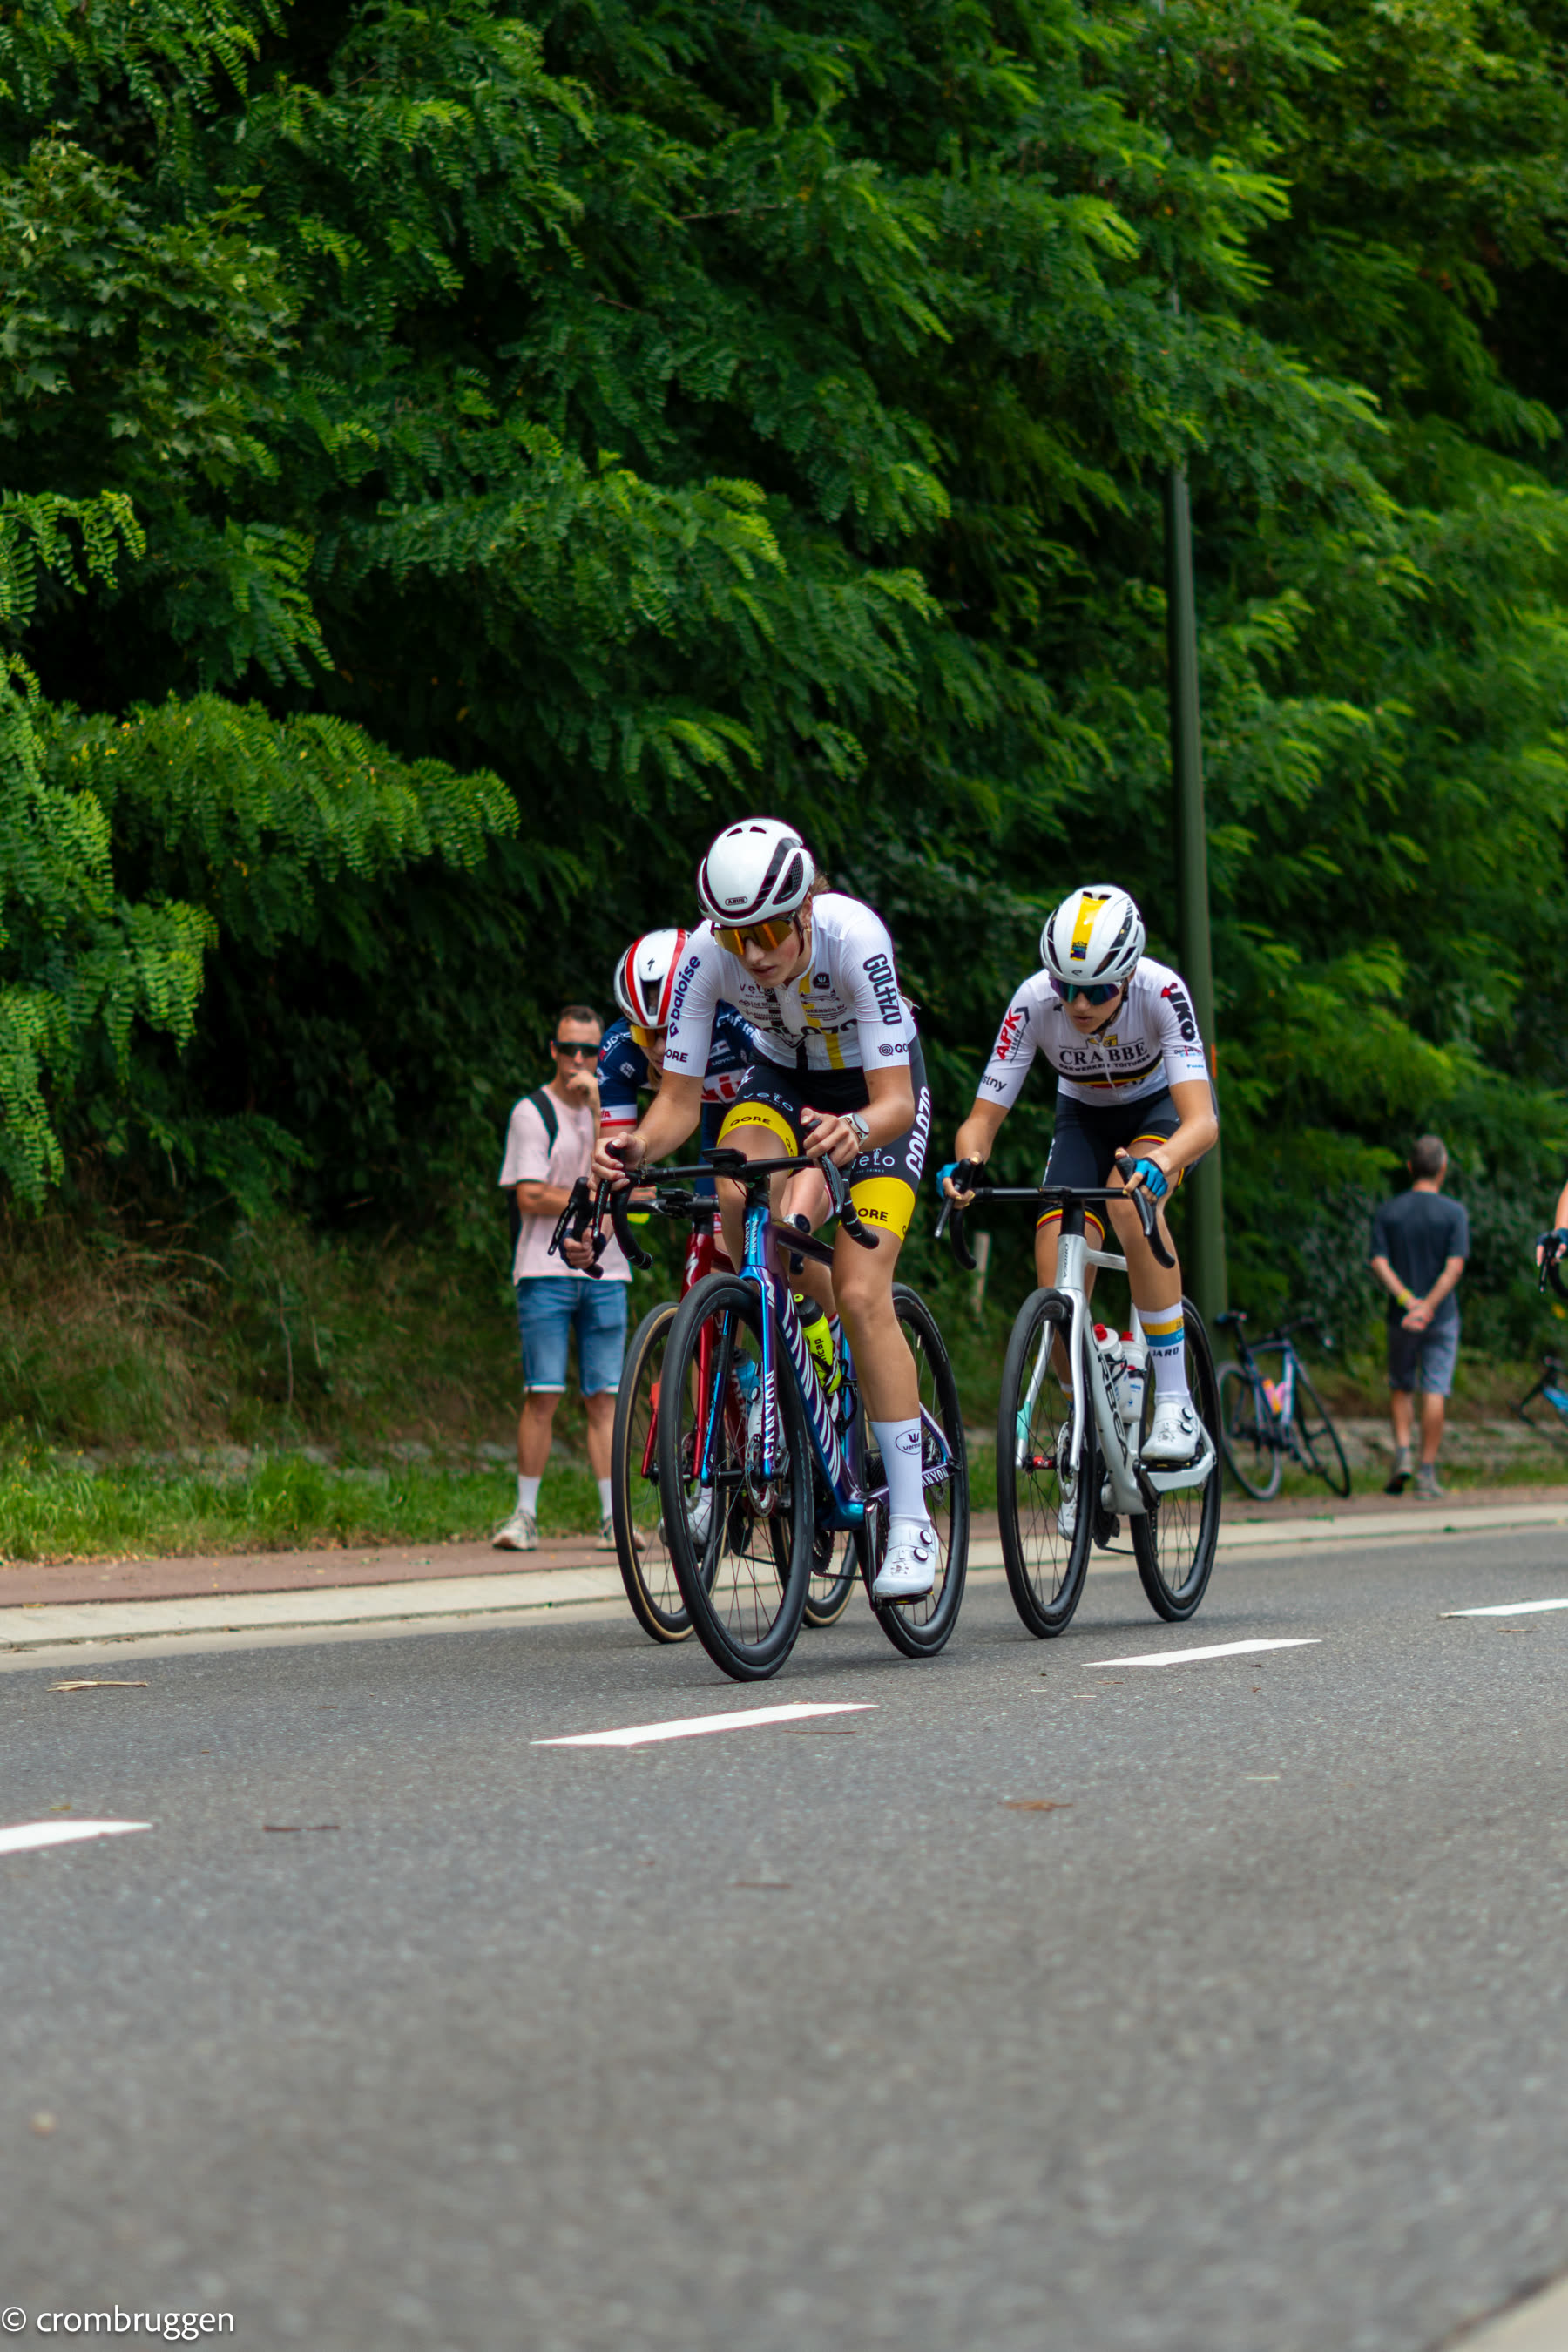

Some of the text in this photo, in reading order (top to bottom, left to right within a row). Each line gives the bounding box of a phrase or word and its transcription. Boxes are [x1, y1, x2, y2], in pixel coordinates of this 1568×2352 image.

[671, 956, 701, 1021] baloise
[862, 953, 902, 1026] GOLAZO
[996, 1007, 1023, 1060] APK
[1058, 1042, 1148, 1065] CRABBE
[729, 1115, 772, 1127] QORE
[763, 1369, 775, 1460] CANYON
